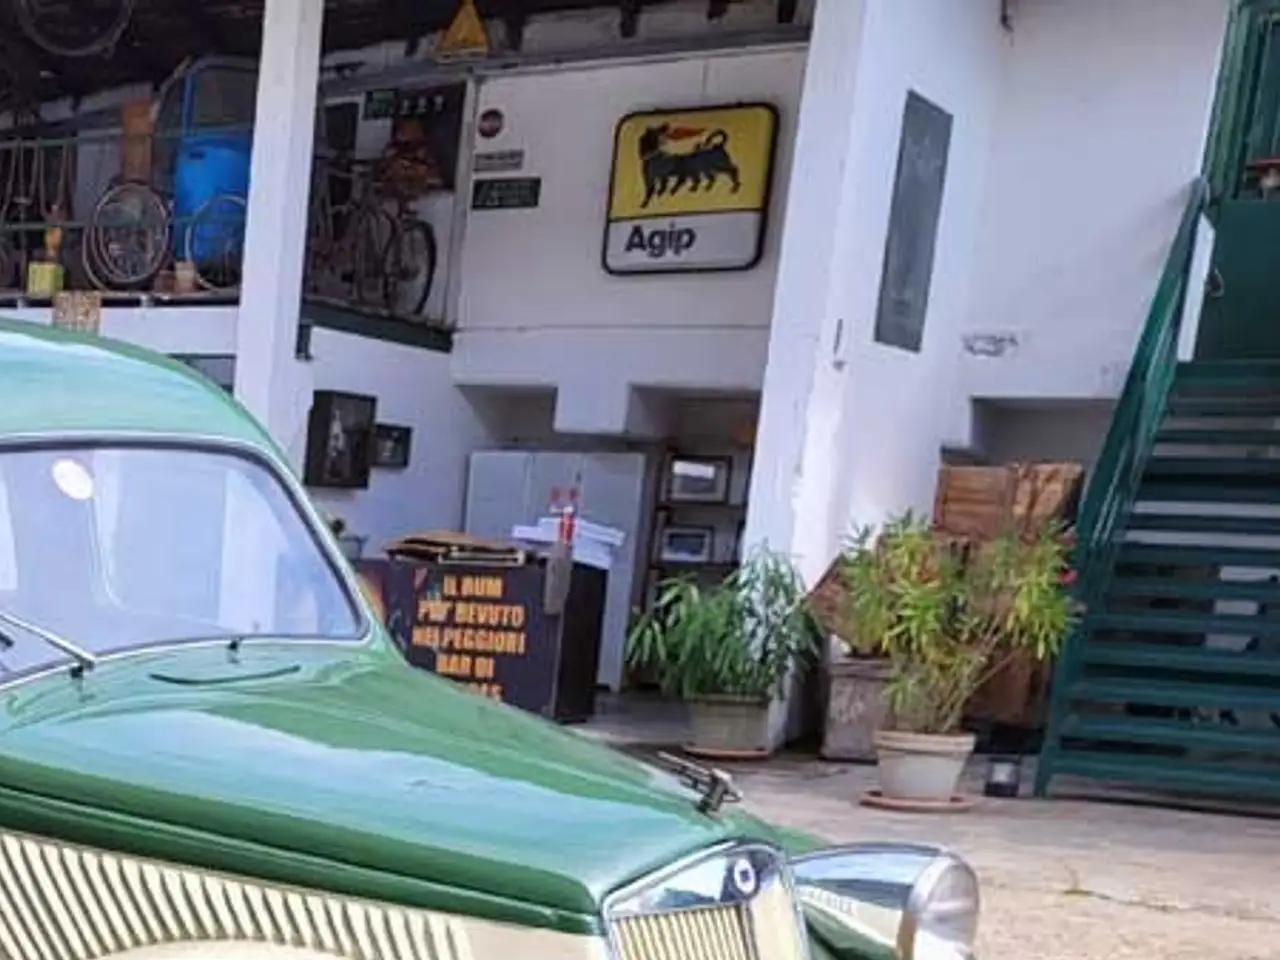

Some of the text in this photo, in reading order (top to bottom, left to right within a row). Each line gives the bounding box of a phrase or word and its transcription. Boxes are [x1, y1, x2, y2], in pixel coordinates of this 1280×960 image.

[624, 221, 696, 258] Agip
[443, 574, 504, 599] IL RUM
[455, 602, 526, 627] BEVUTO
[411, 625, 527, 654] NEI PEGGIORI
[436, 653, 495, 679] BAR DI
